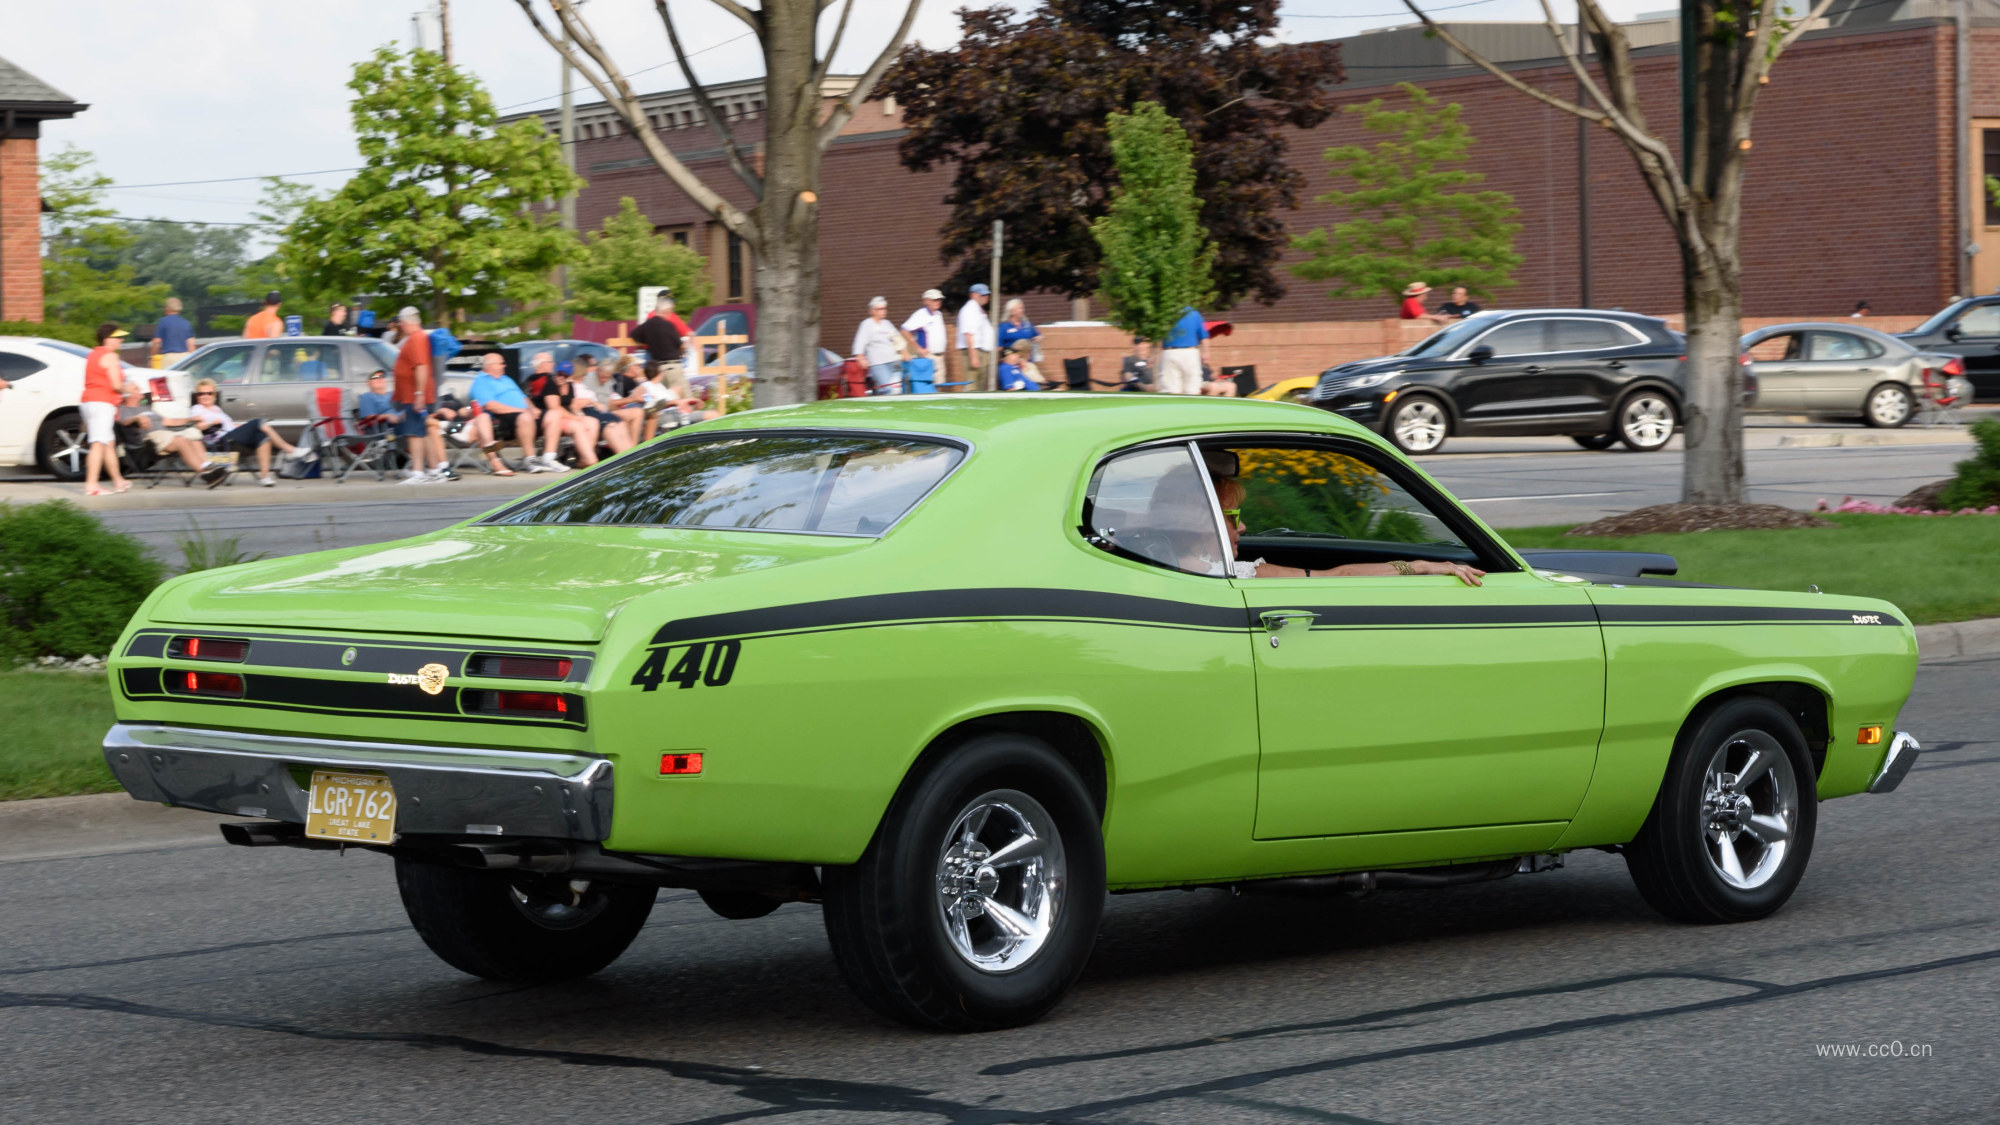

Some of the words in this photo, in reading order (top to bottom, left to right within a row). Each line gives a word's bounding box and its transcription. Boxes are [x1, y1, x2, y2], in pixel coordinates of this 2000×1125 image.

[1851, 614, 1882, 625] DUSTER
[630, 640, 742, 692] 440
[331, 775, 375, 786] MICHIGAN
[328, 818, 350, 827] GREAT
[353, 820, 372, 829] LAKE
[338, 827, 359, 837] STATE
